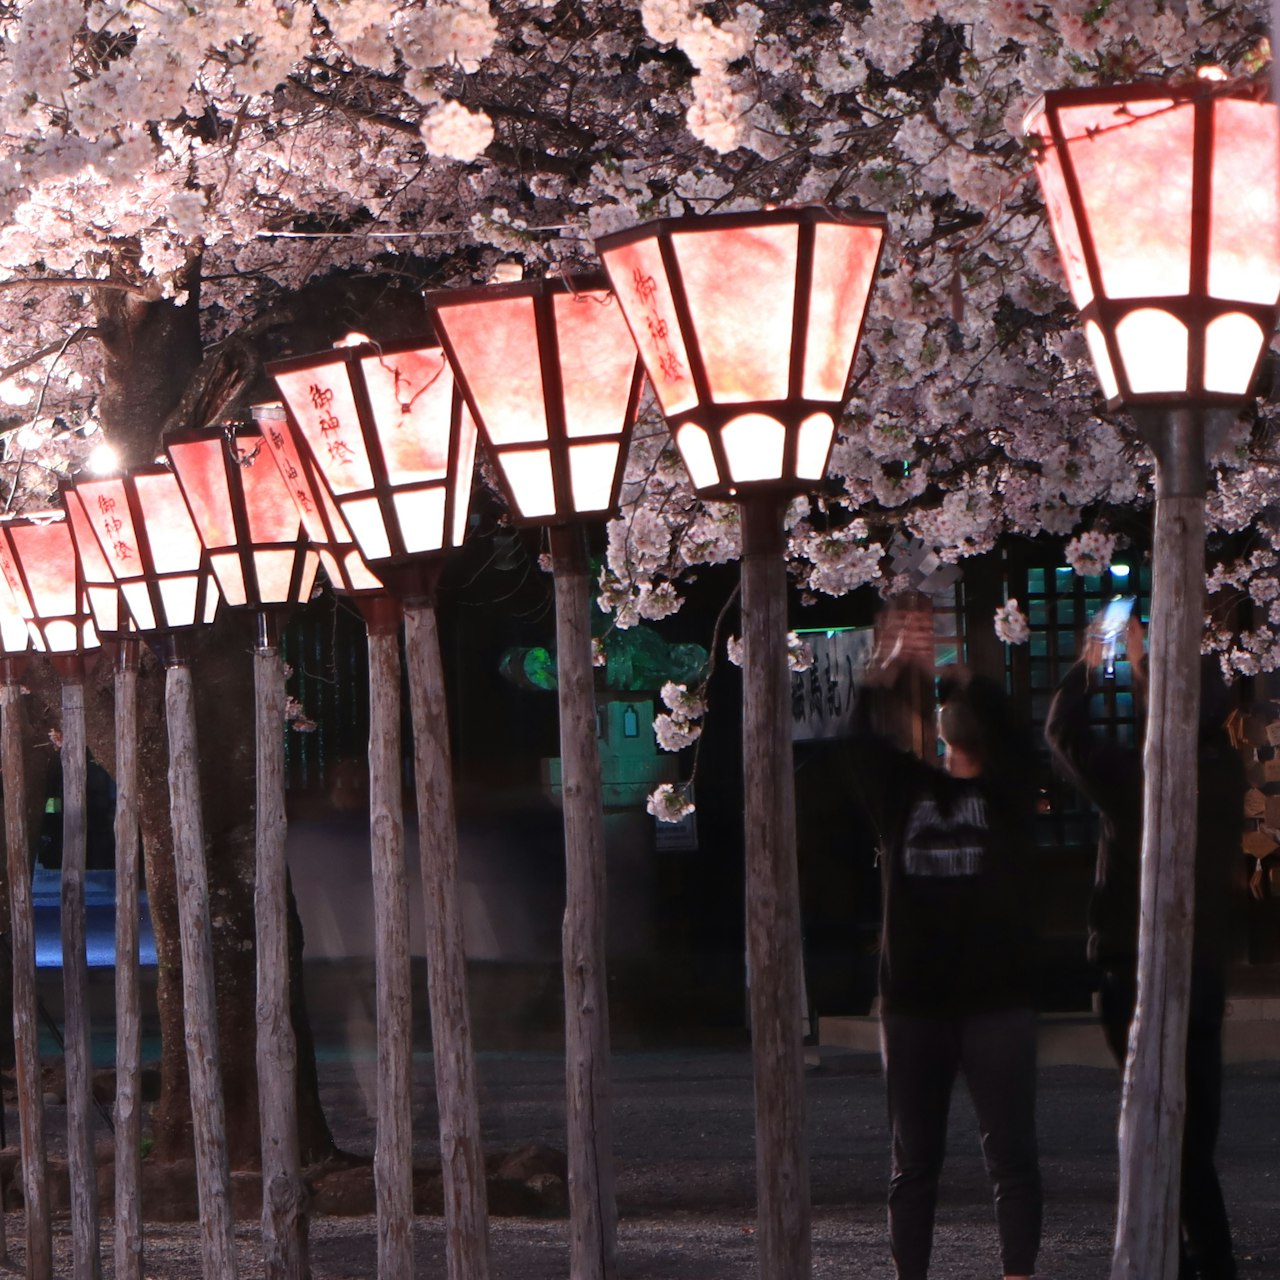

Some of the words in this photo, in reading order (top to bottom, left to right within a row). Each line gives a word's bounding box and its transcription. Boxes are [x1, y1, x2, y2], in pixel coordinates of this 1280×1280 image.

[632, 267, 685, 381] 御神燈
[309, 383, 356, 466] 御神燈
[98, 494, 134, 561] 御神燈
